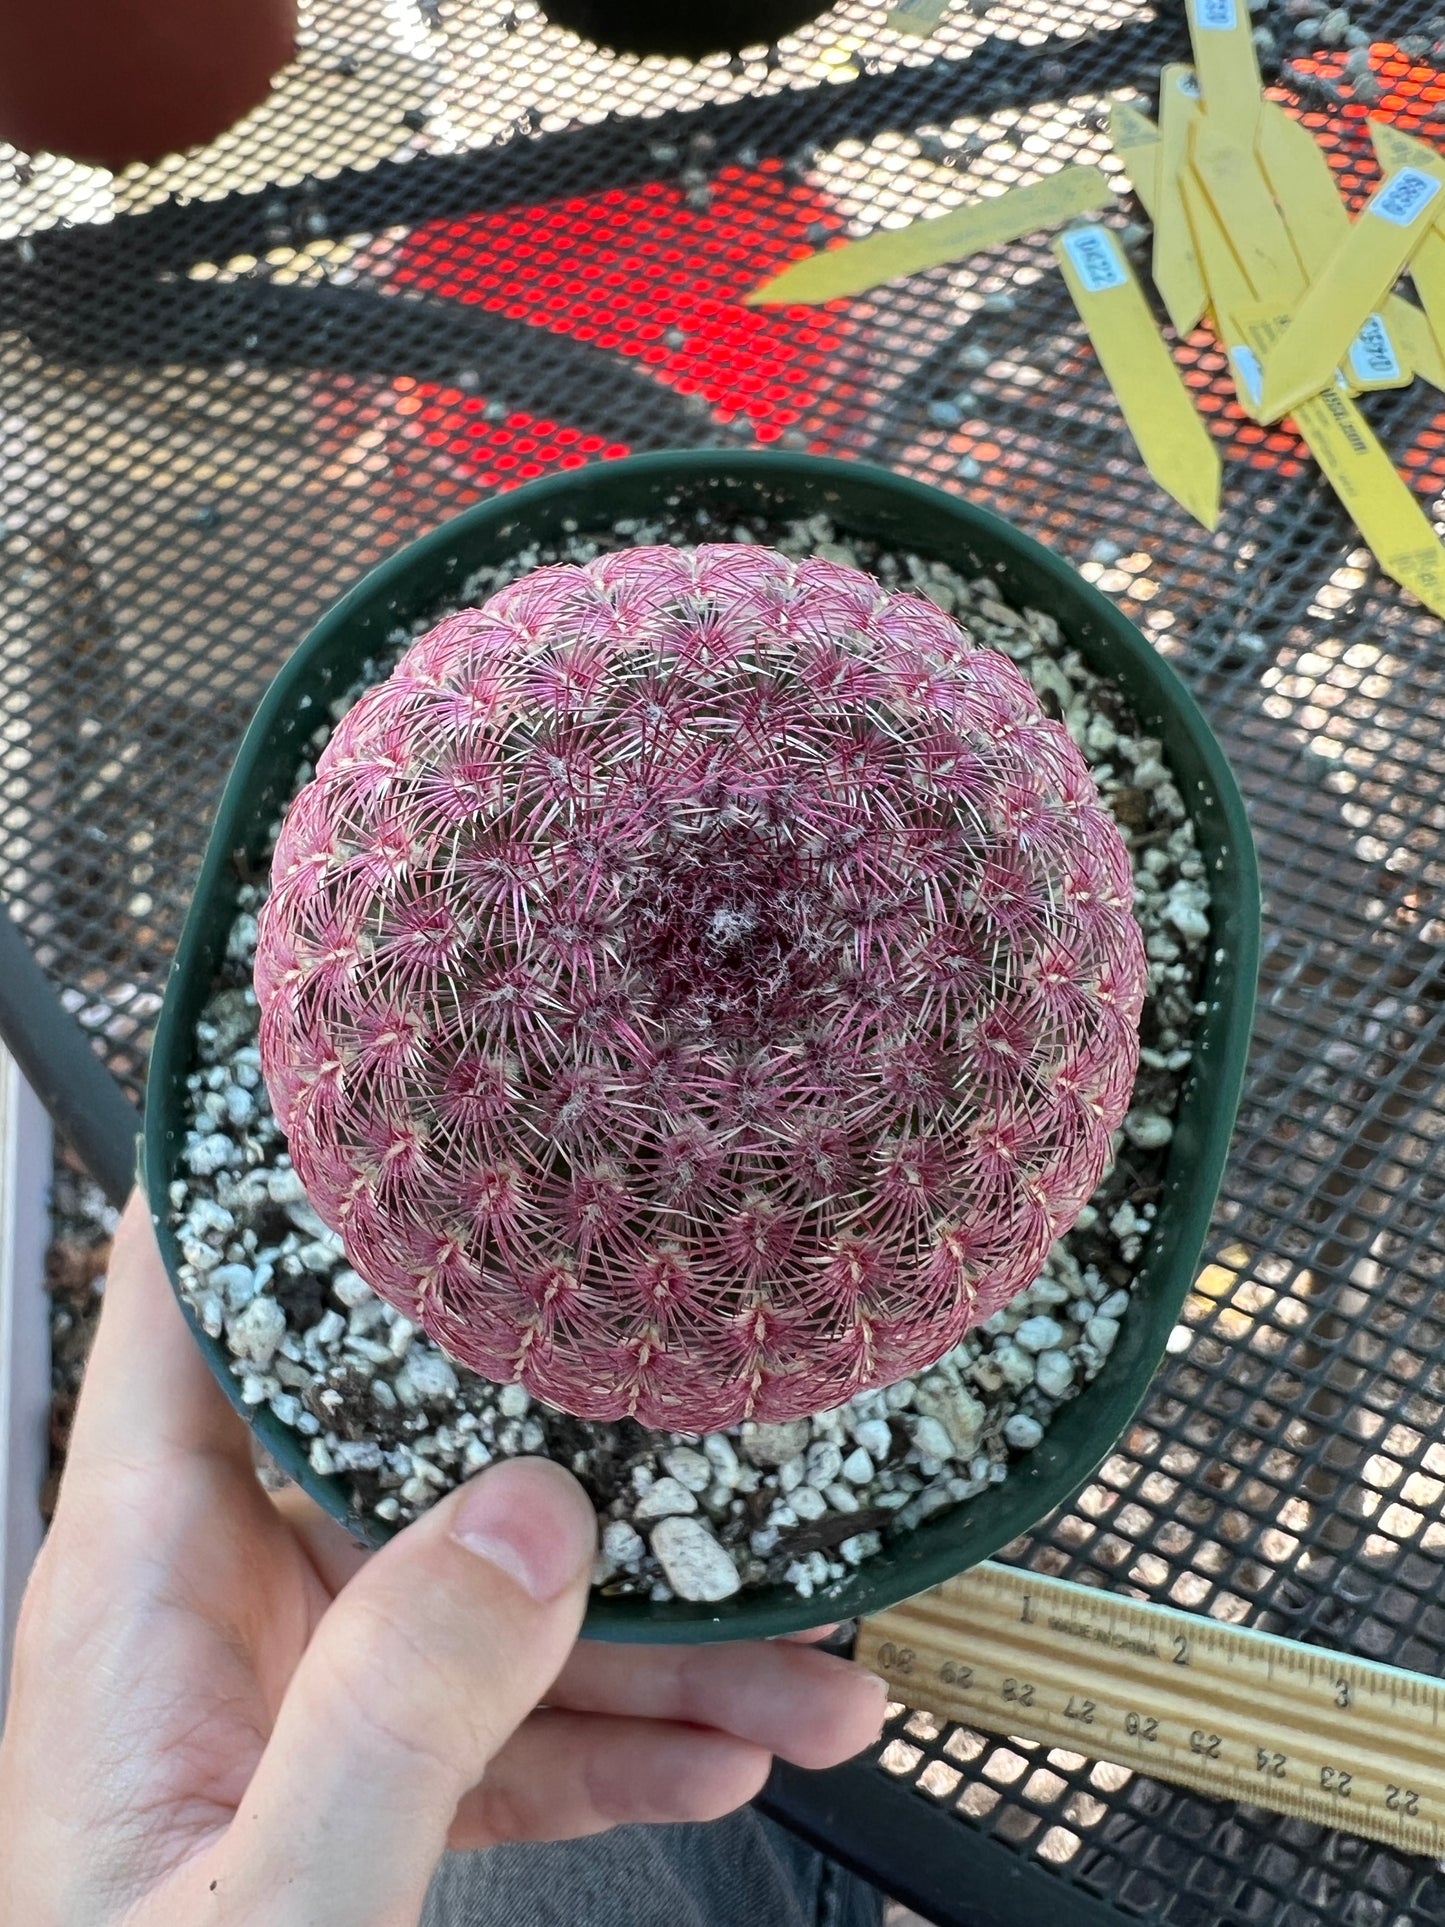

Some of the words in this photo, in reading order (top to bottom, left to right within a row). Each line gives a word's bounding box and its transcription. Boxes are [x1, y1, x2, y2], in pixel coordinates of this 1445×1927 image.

[877, 1641, 916, 1674] 30
[1020, 1595, 1034, 1624] 1
[1172, 1634, 1190, 1666] 2
[1334, 1678, 1349, 1708] 3
[940, 1660, 974, 1690] 29
[1003, 1677, 1036, 1707] 28
[1063, 1695, 1097, 1724] 27
[1125, 1711, 1159, 1742] 26
[1189, 1729, 1223, 1759] 25
[1256, 1748, 1287, 1779] 24
[1320, 1766, 1352, 1798] 23
[1385, 1783, 1420, 1816] 22
